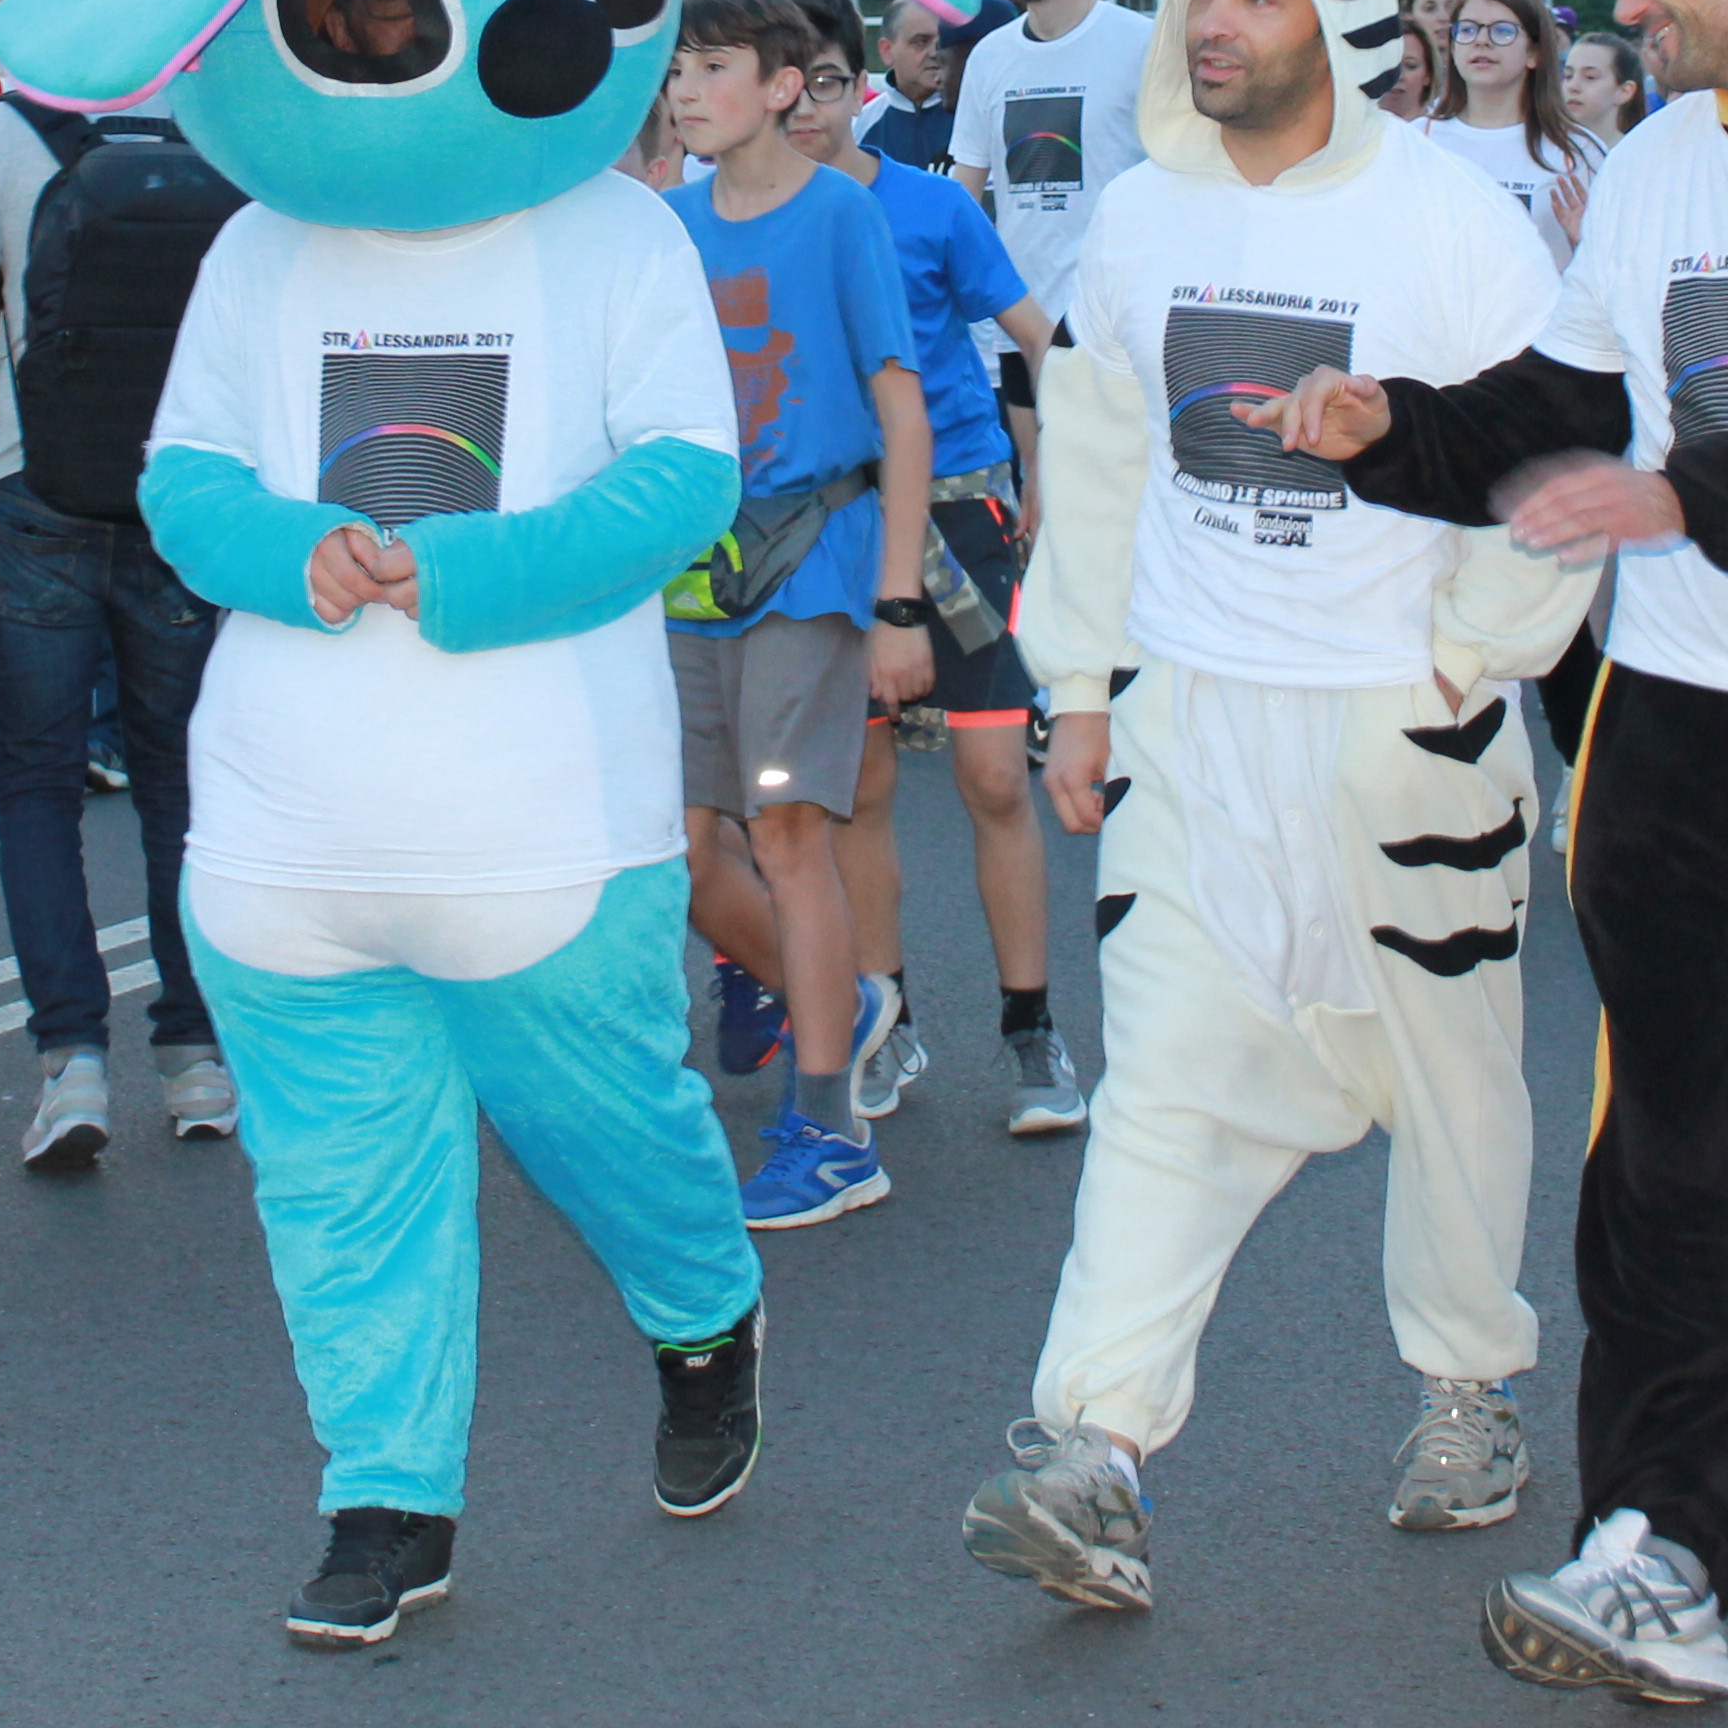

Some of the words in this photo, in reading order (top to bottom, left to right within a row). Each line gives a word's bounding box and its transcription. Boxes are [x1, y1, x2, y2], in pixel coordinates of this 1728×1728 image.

[1511, 181, 1535, 191] 2017
[1318, 298, 1361, 316] 2017
[475, 332, 515, 348] 2017
[1235, 485, 1259, 504] LE
[1261, 488, 1343, 508] SPONDE
[1254, 511, 1313, 532] fondazione
